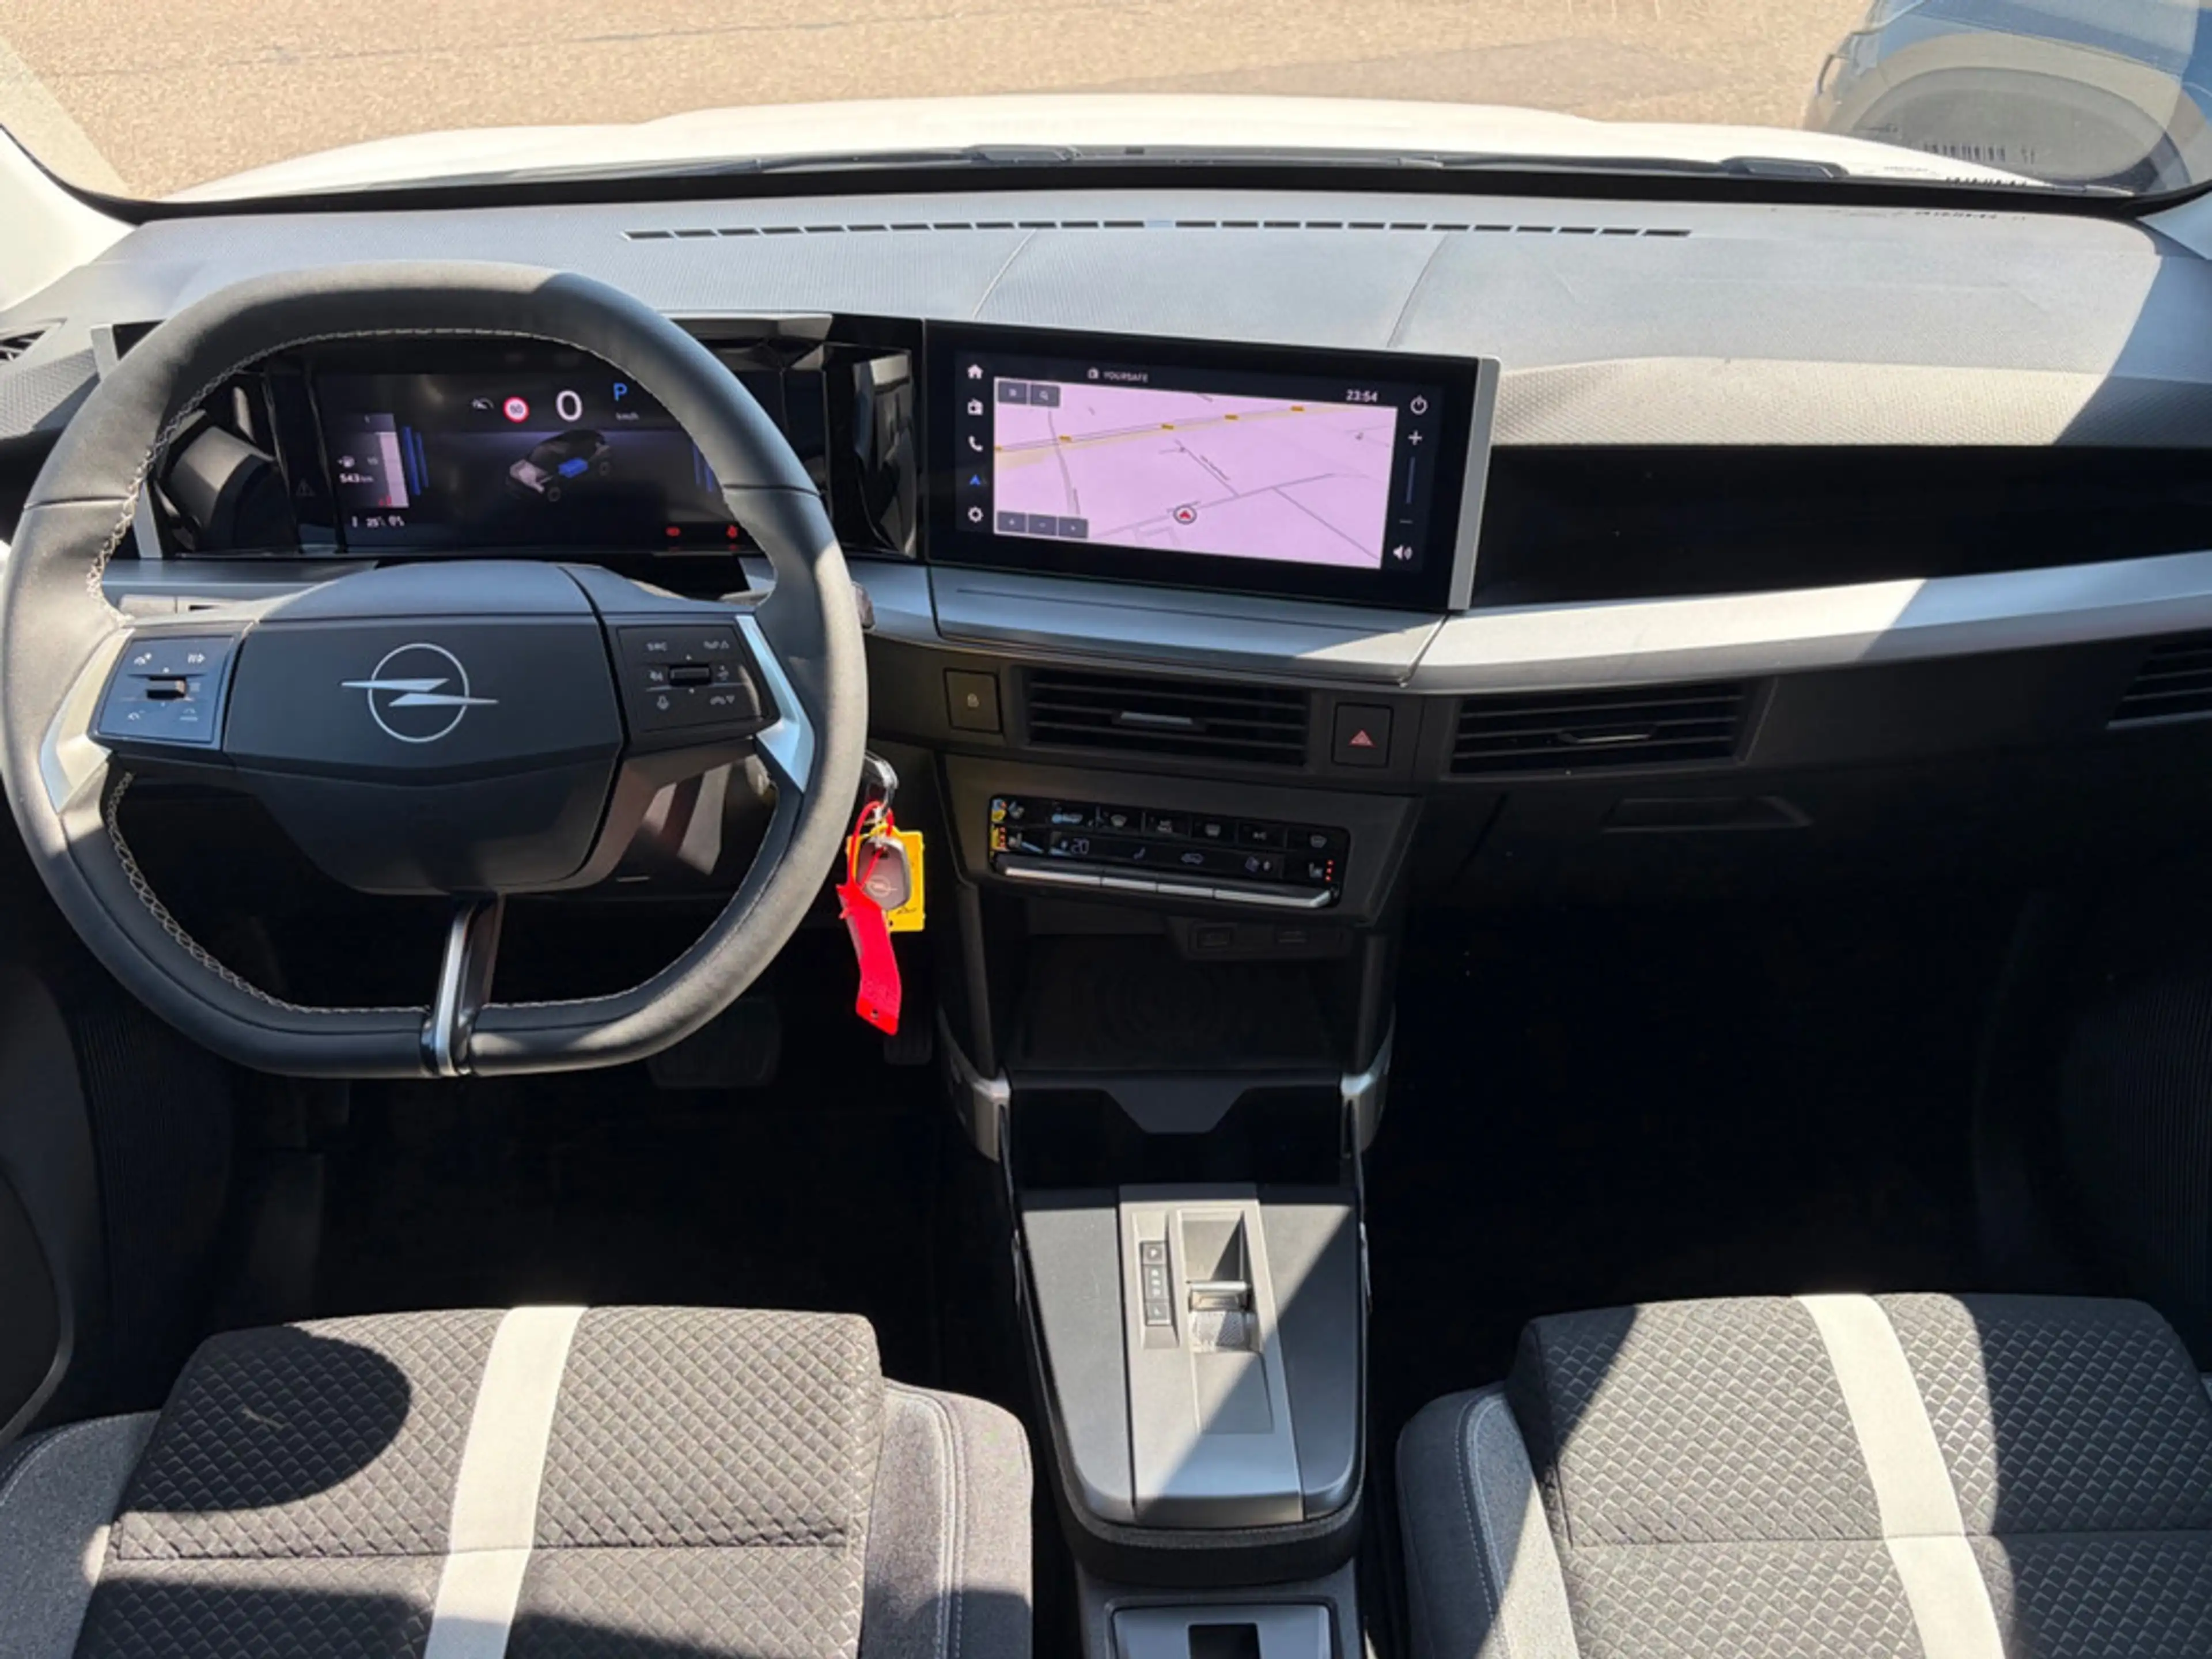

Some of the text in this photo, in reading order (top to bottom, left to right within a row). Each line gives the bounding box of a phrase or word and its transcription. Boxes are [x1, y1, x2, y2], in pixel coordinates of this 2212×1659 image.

[613, 382, 627, 401] P
[1346, 389, 1378, 403] 23:54
[556, 390, 582, 422] 0
